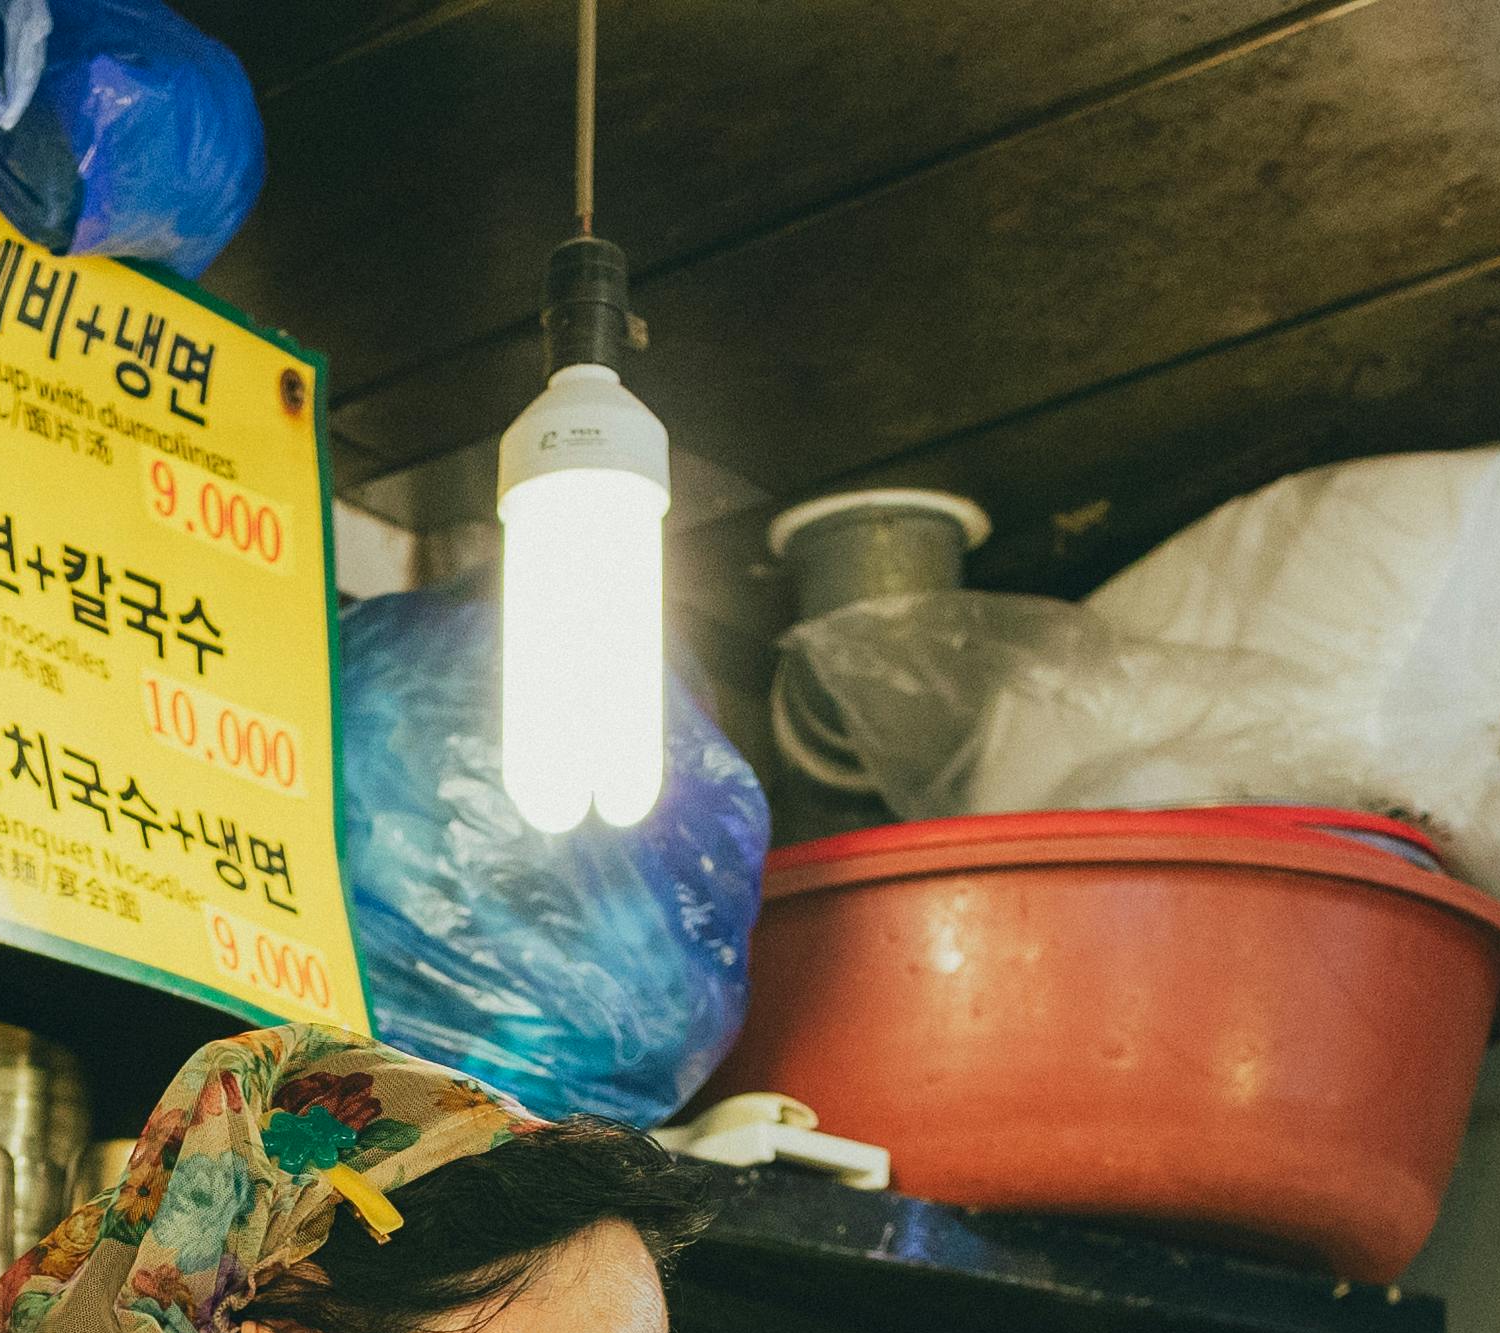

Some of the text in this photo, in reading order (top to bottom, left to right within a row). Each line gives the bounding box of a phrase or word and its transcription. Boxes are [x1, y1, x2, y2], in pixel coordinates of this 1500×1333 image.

[150, 460, 281, 563] 9.000
[146, 679, 297, 788] 10.000
[213, 914, 330, 1010] 9.000
